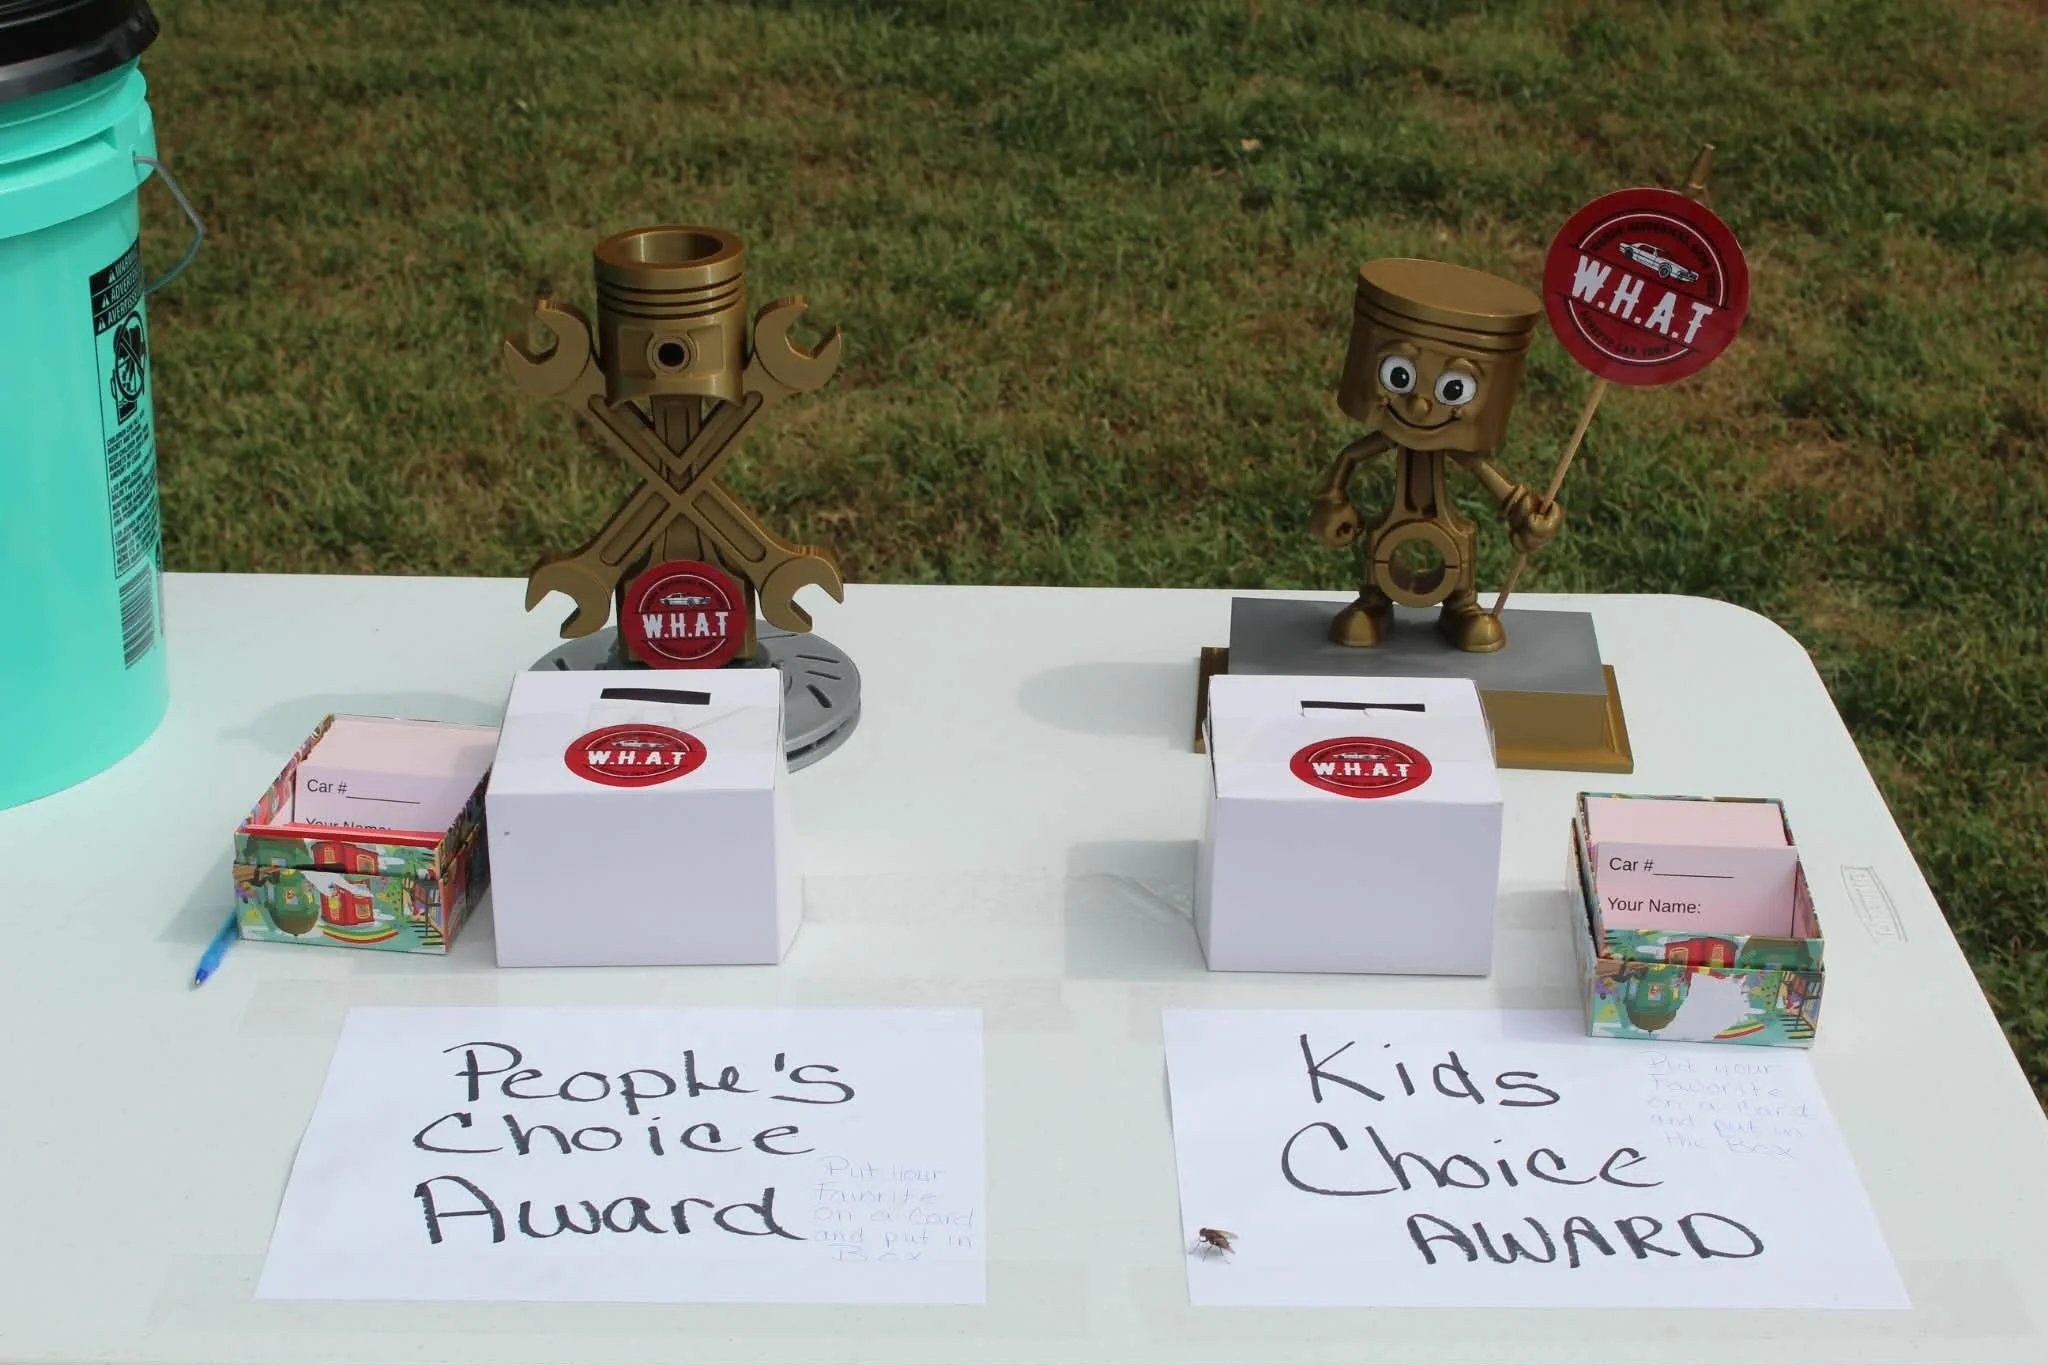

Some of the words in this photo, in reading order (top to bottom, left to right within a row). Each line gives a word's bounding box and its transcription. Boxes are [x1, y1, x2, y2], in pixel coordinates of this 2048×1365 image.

[1571, 255, 1714, 345] W.H.A.T
[642, 611, 729, 639] W.H.A.T
[587, 750, 686, 766] W.H.A.T
[1312, 762, 1411, 778] W.H.A.T
[307, 779, 334, 793] Car
[1609, 857, 1639, 872] Car
[1607, 897, 1644, 912] Your
[1649, 898, 1701, 914] Name:
[442, 1041, 855, 1116] People's
[1300, 1033, 1560, 1107] Kids
[413, 1111, 816, 1156] Choice
[820, 1155, 882, 1177] Put
[892, 1165, 946, 1182] your
[1281, 1121, 1665, 1196] Choice
[414, 1174, 809, 1245] Award
[813, 1226, 865, 1243] and
[1406, 1211, 1765, 1269] AWARD
